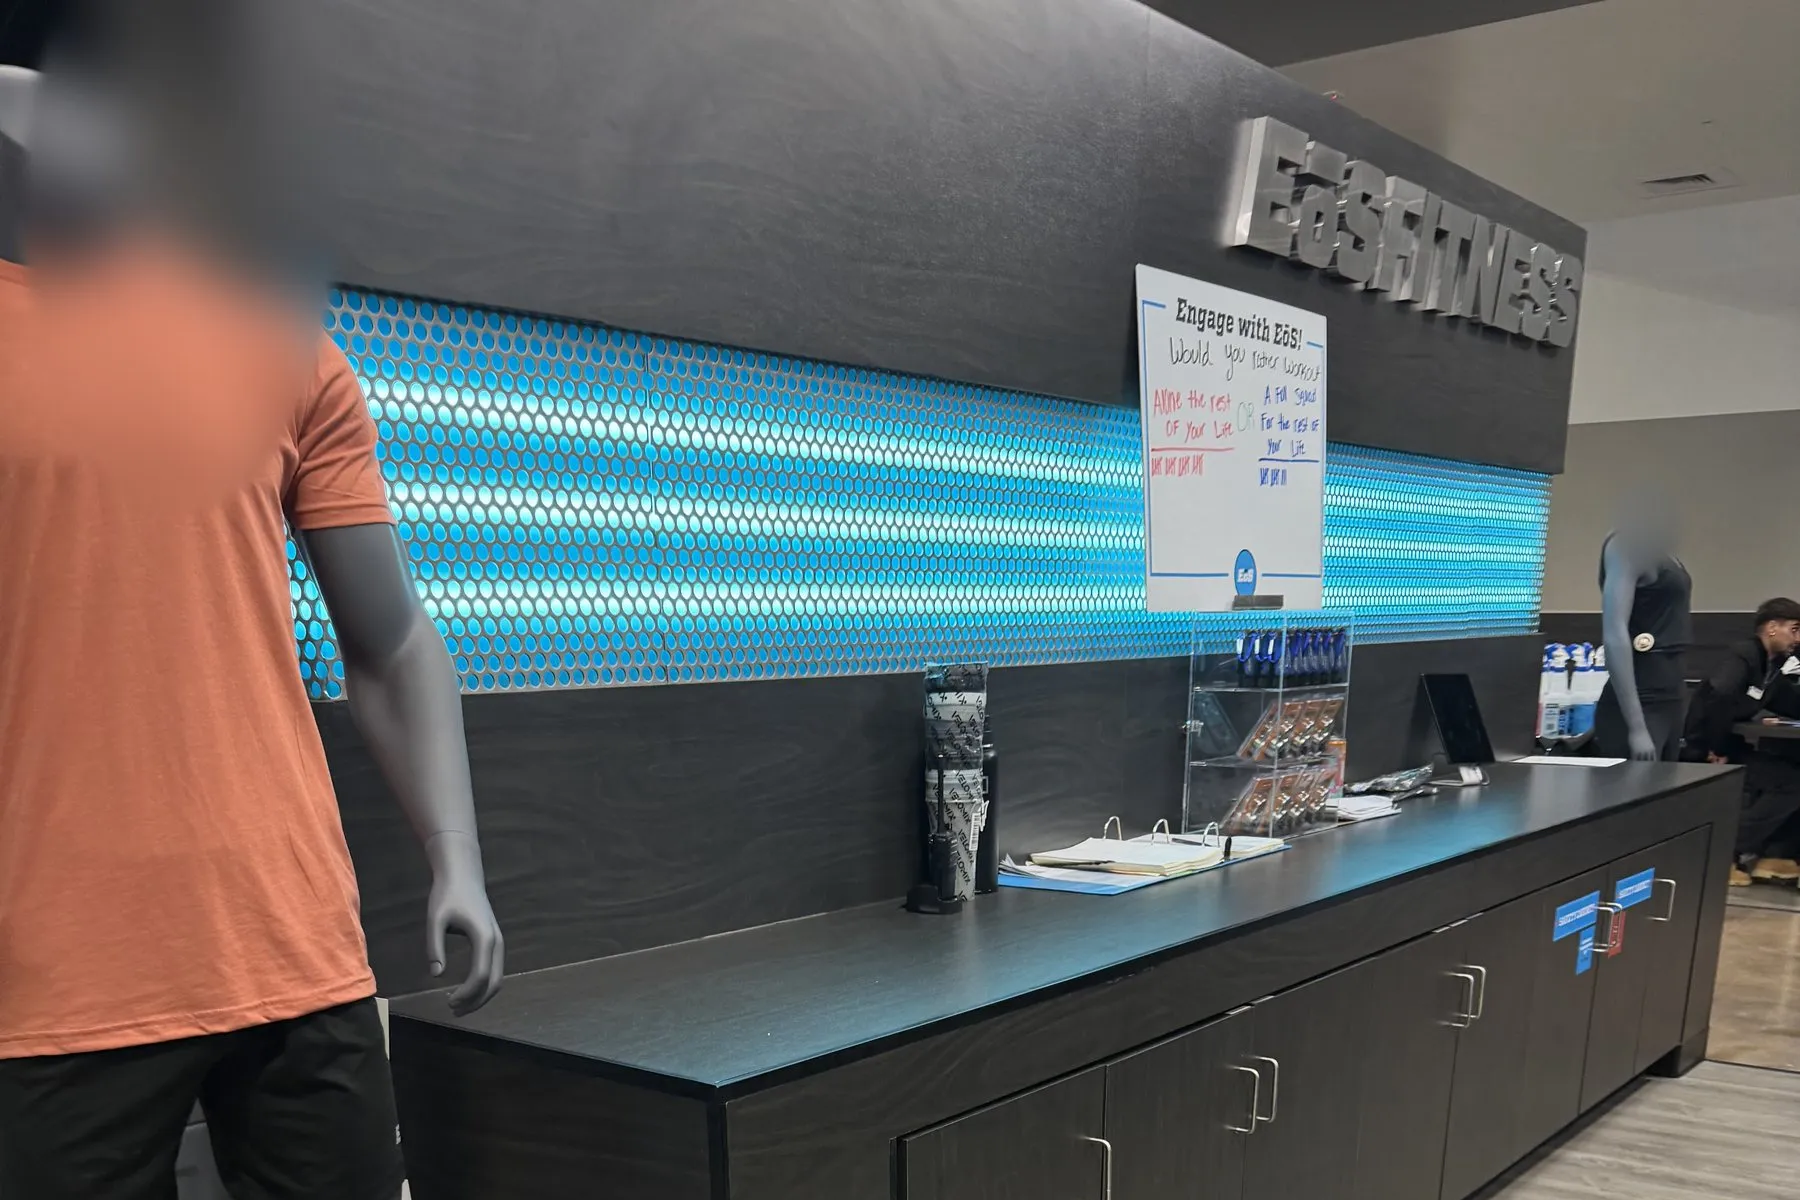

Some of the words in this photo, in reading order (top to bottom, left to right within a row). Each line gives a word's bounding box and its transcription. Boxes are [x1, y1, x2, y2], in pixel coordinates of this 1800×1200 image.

[1176, 297, 1234, 337] Engage
[1239, 314, 1270, 343] with
[1170, 337, 1213, 367] Would
[1187, 389, 1206, 409] the
[1277, 412, 1290, 431] the
